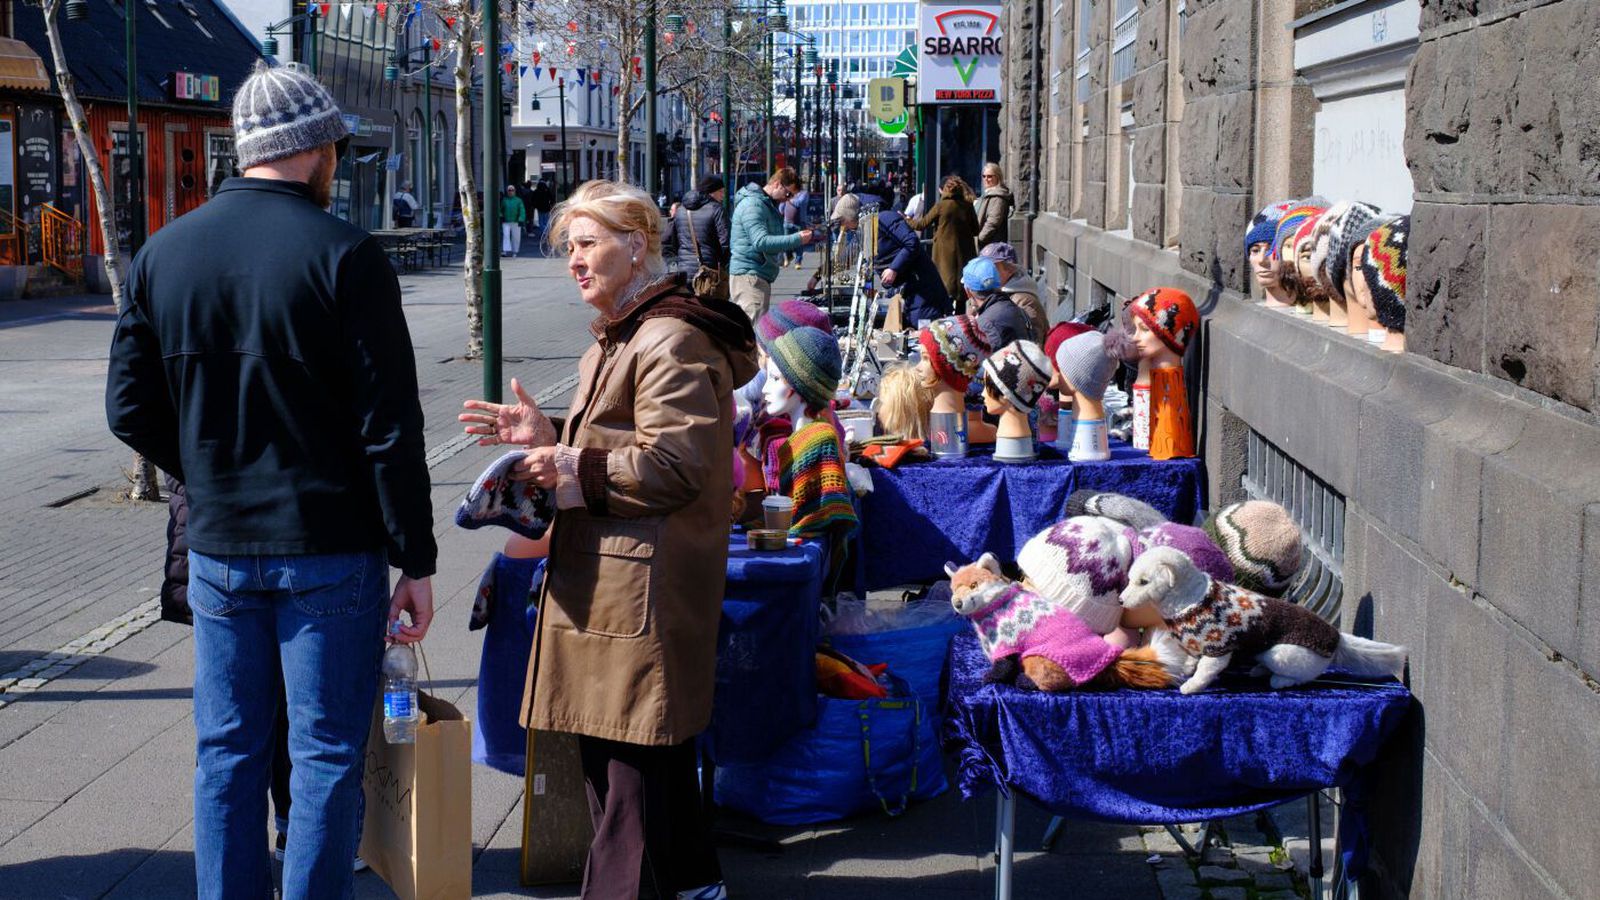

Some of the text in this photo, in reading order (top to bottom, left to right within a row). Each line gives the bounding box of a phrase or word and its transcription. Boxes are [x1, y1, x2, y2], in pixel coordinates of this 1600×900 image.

[935, 89, 995, 99] NEW YORK PIZZA
